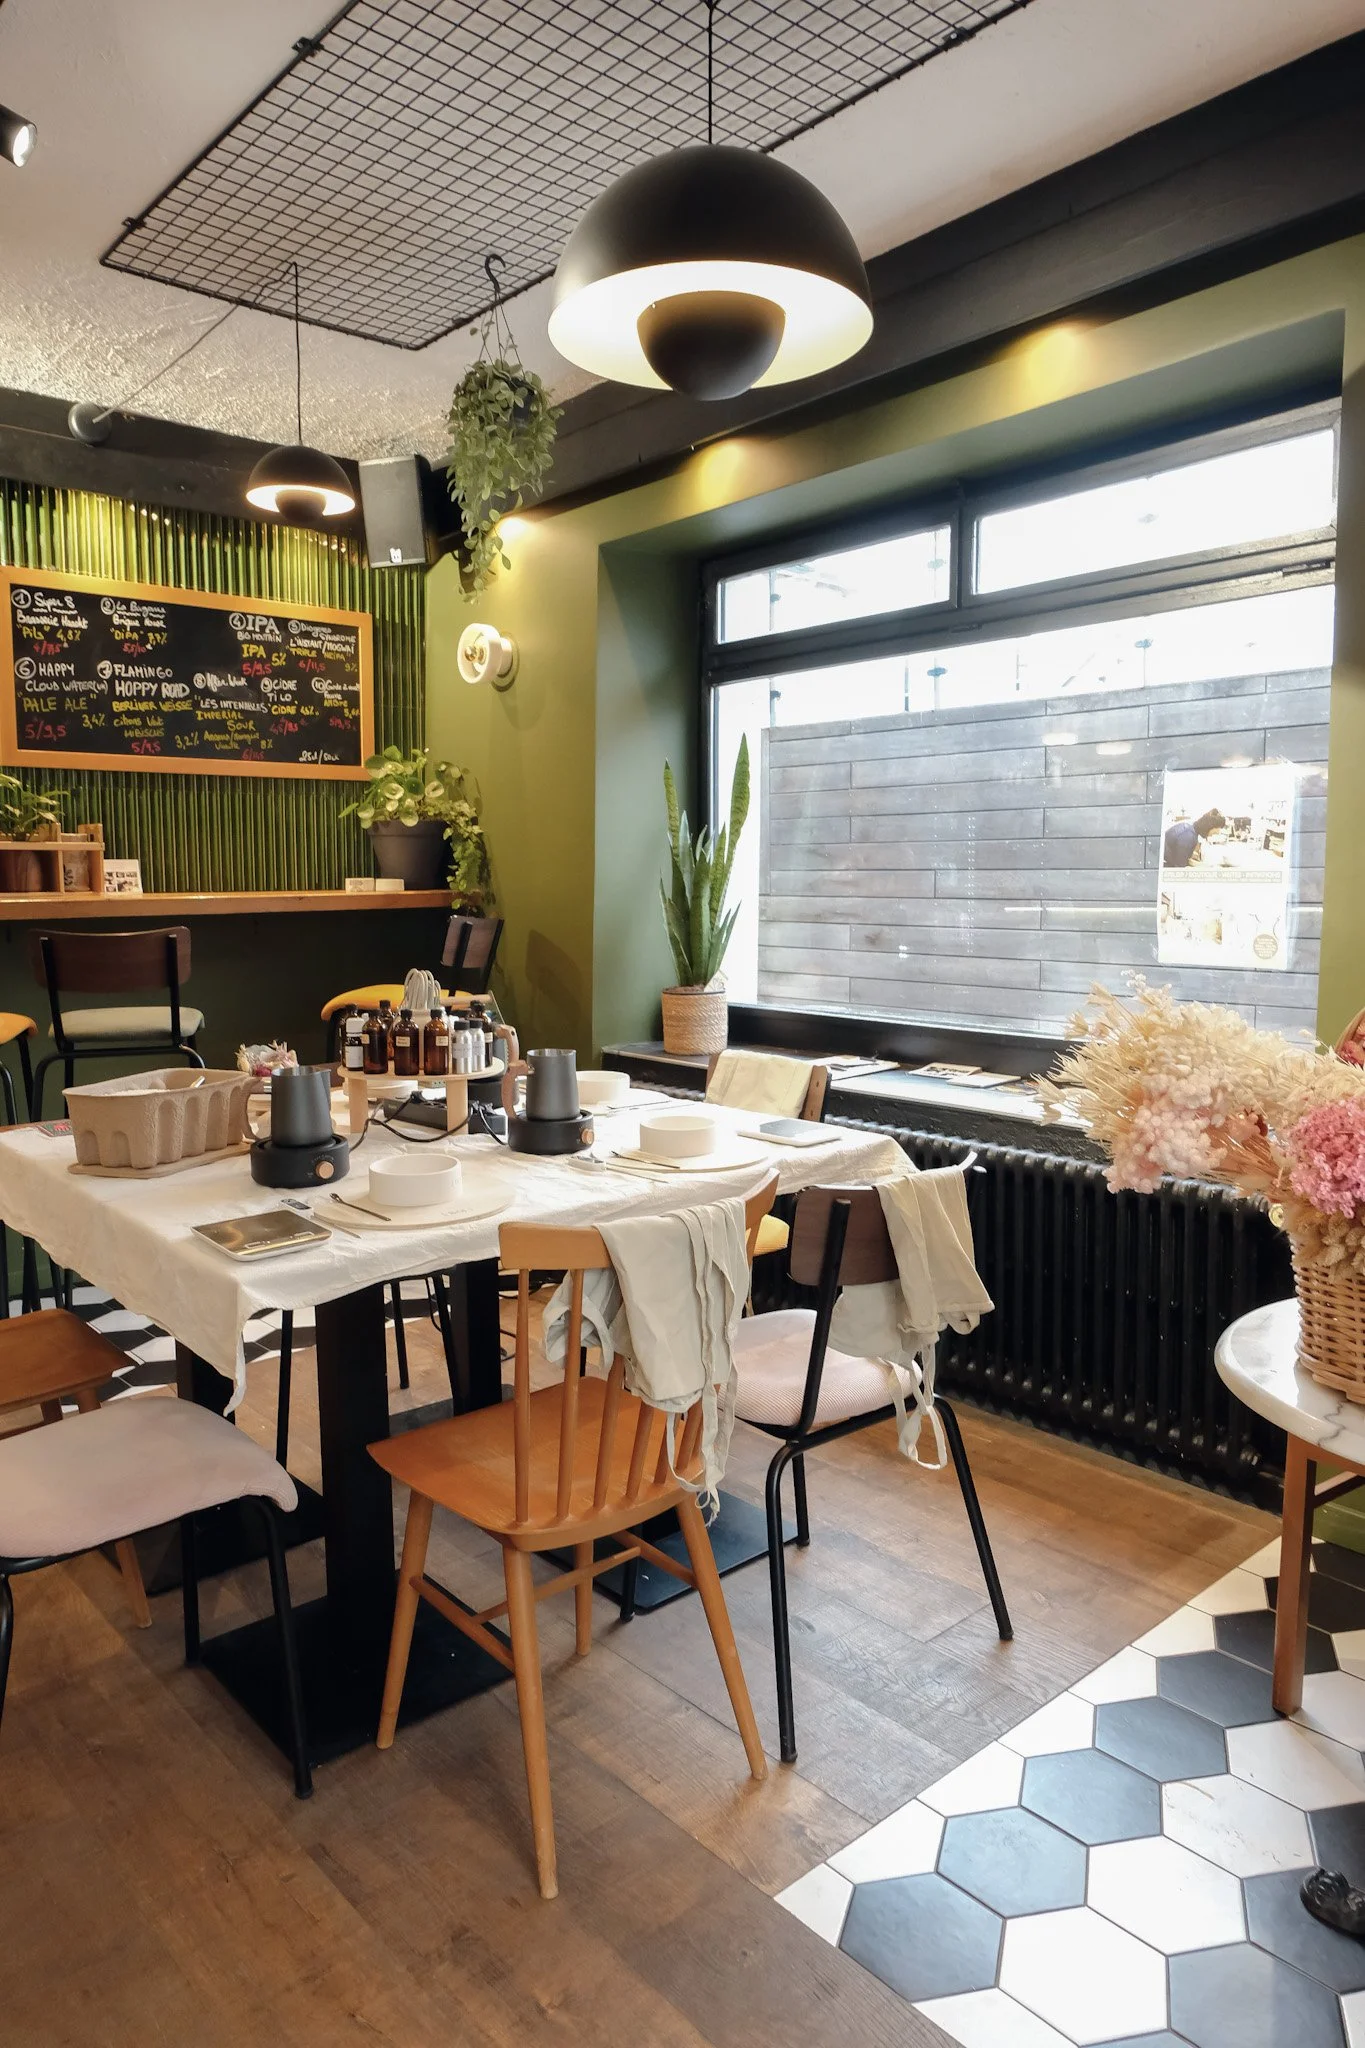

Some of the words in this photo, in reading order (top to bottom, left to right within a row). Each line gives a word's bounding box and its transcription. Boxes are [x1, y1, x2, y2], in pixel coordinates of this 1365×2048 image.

[246, 614, 280, 635] IPA
[241, 644, 267, 658] IPA
[38, 662, 75, 678] HAPPY
[25, 680, 60, 692] CLOUD
[114, 680, 158, 698] HOPPY
